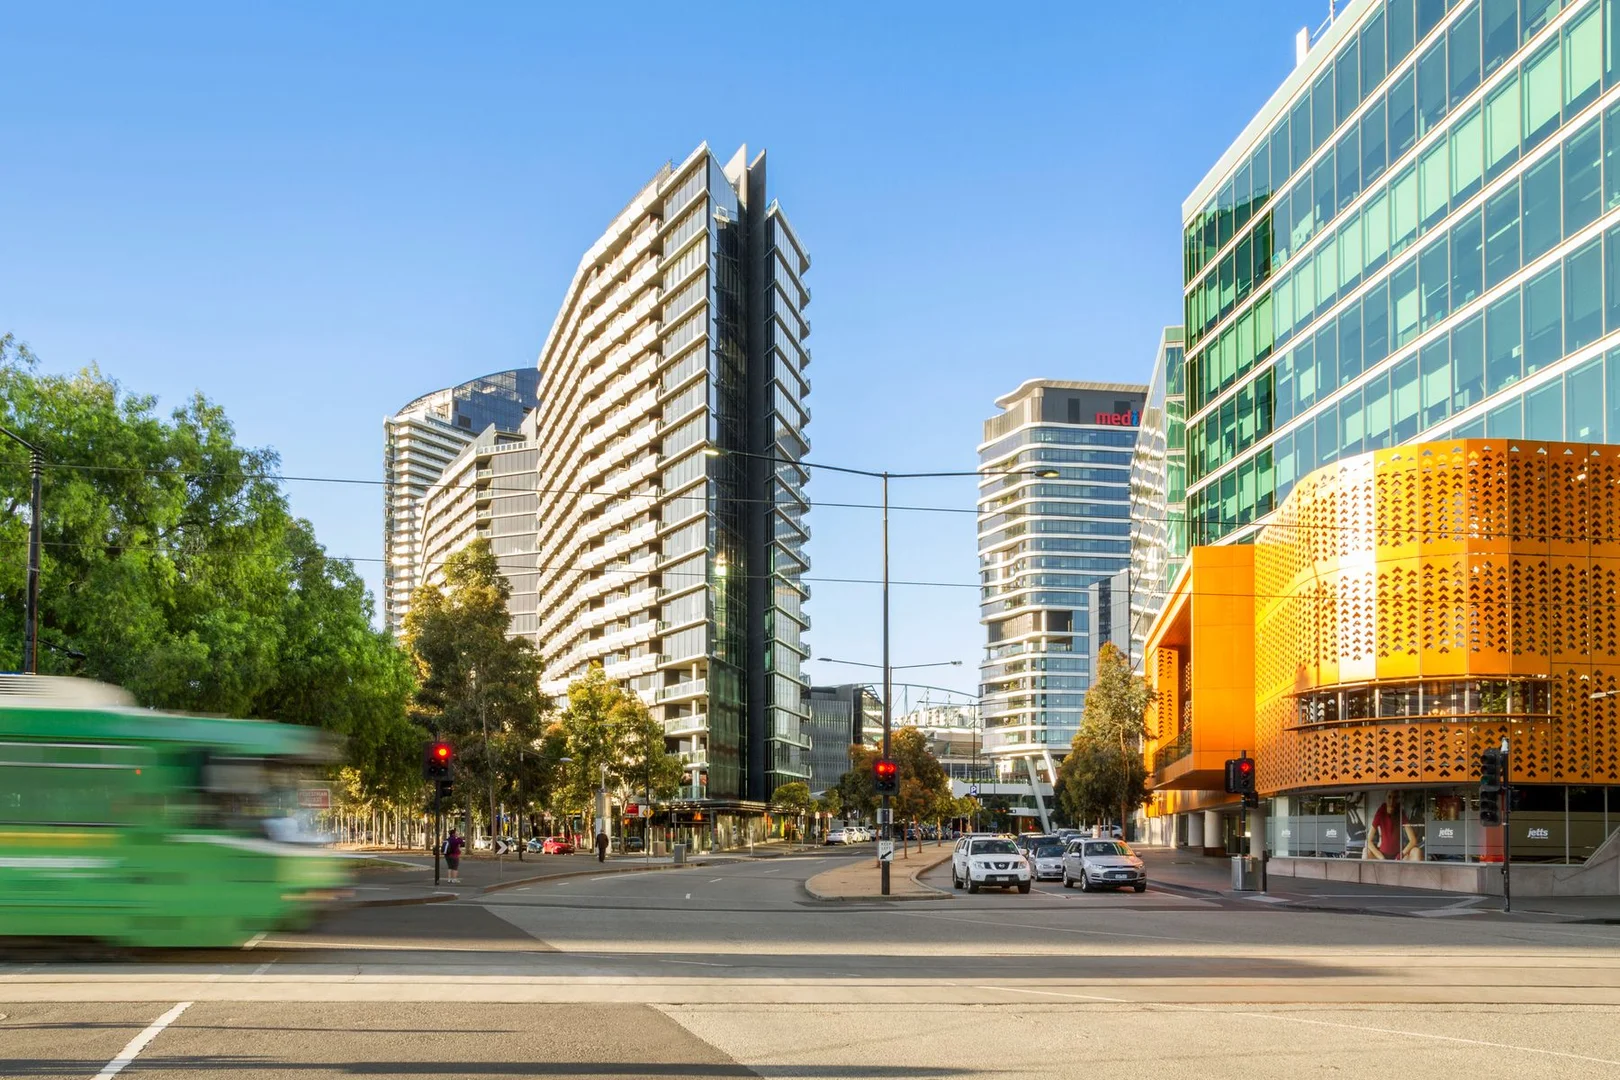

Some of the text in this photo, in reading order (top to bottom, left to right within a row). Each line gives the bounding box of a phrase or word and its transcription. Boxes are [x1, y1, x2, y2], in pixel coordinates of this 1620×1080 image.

[1095, 409, 1142, 426] medi
[1438, 828, 1454, 837] jetts
[1527, 828, 1549, 838] jetts
